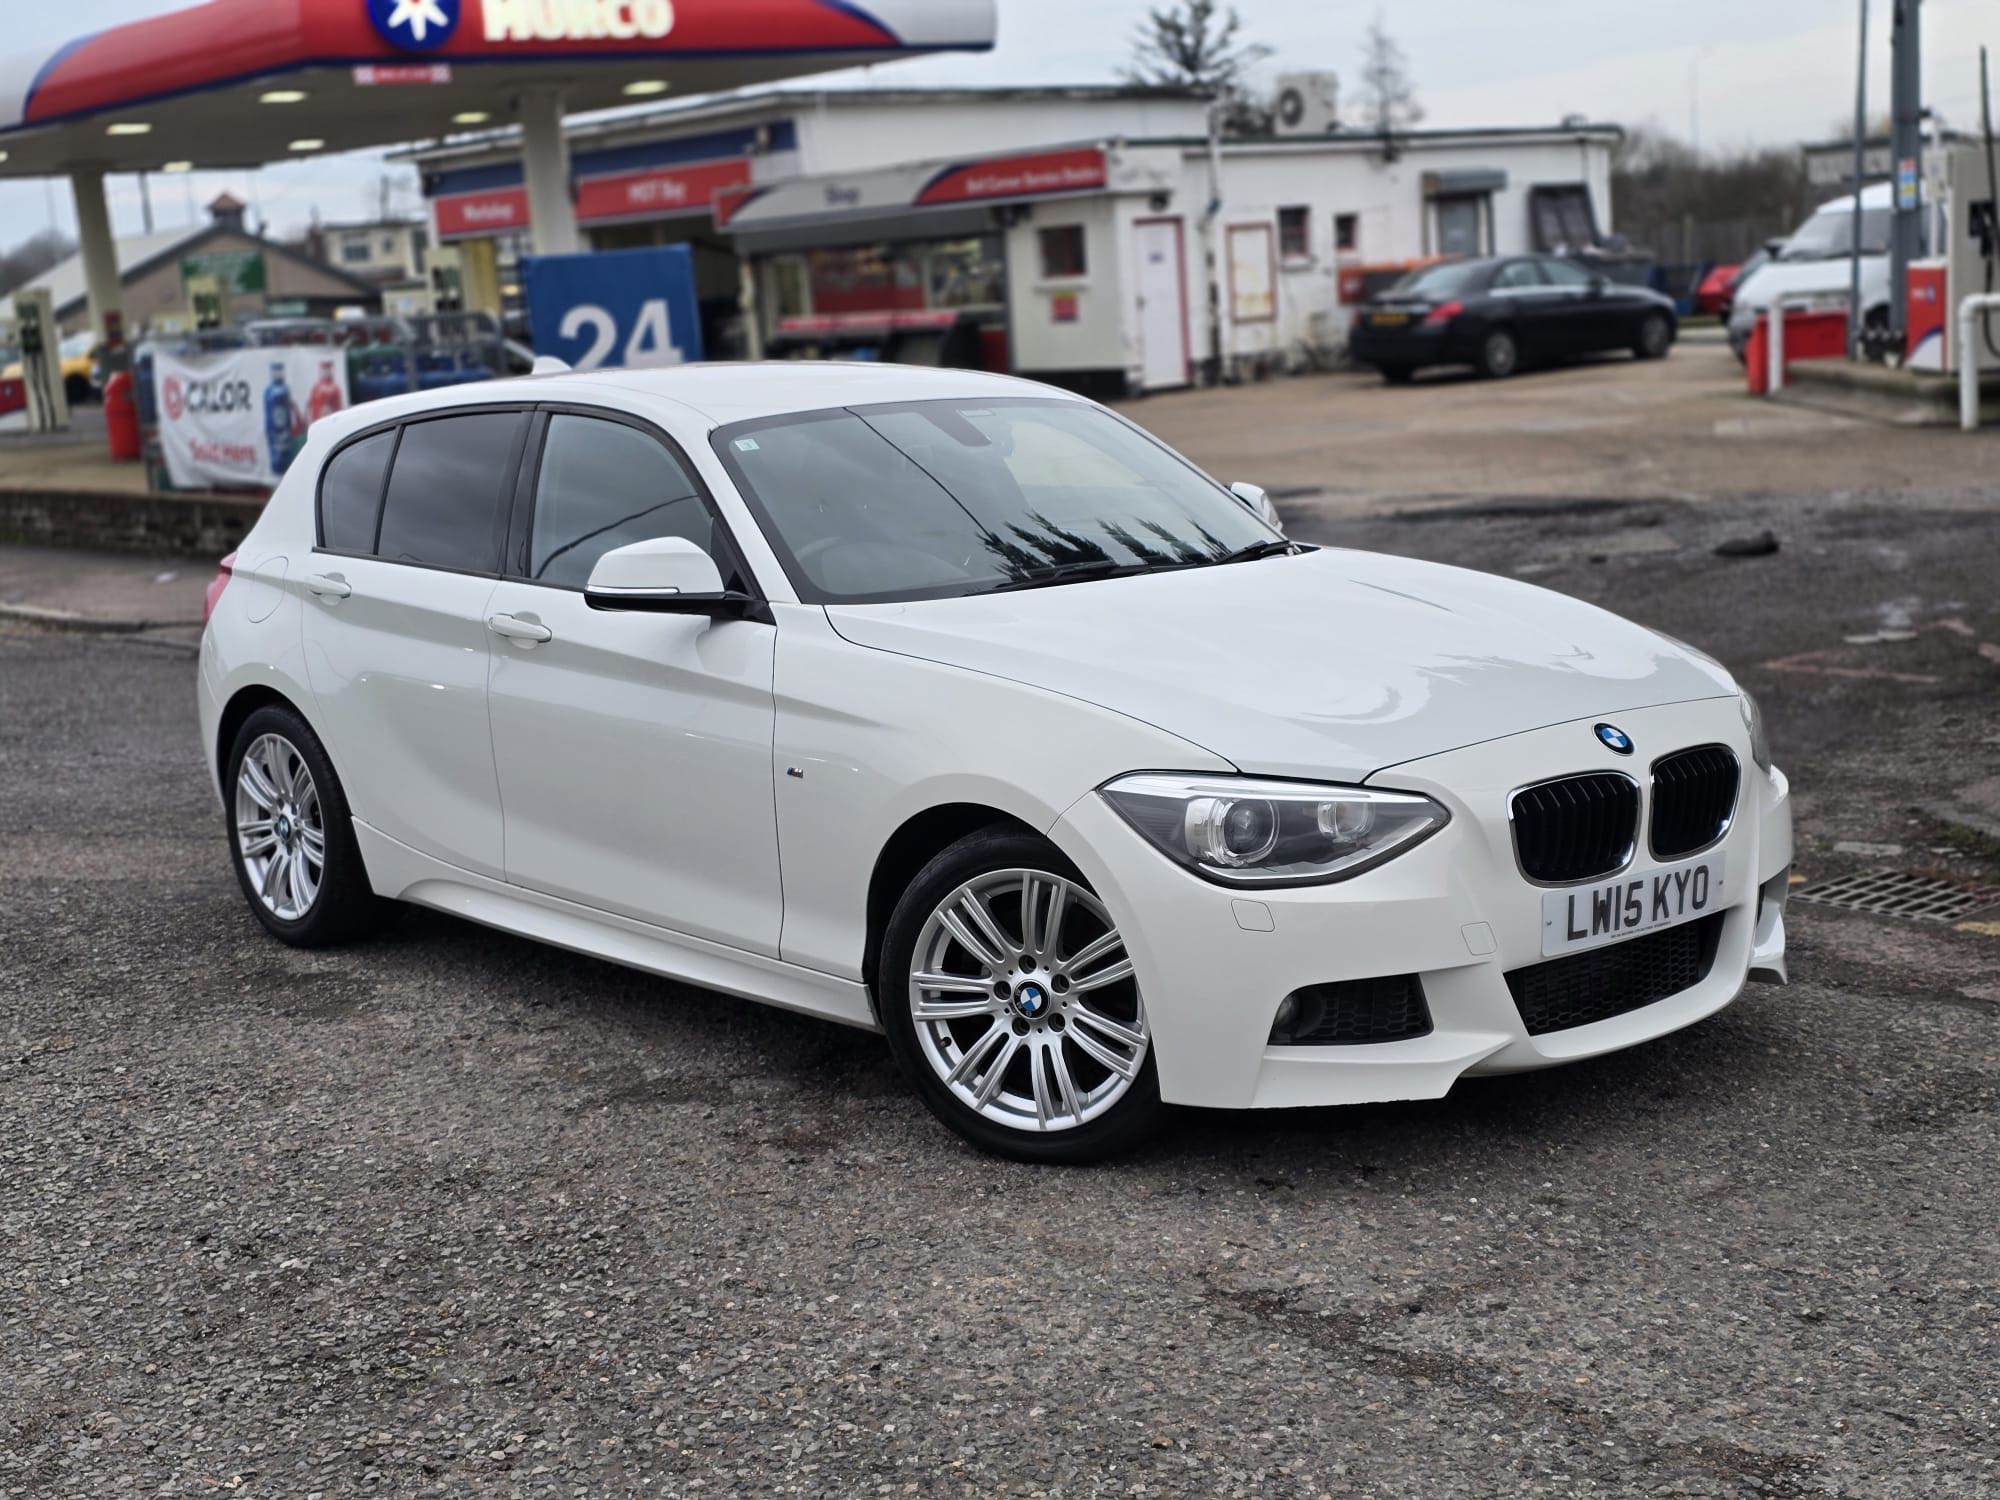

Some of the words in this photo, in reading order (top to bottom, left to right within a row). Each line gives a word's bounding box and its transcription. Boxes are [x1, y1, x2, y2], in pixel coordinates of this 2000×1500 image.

[559, 299, 684, 369] 24
[186, 381, 253, 414] CALOR
[1567, 880, 1644, 941] LW15
[1652, 864, 1709, 922] KYO
